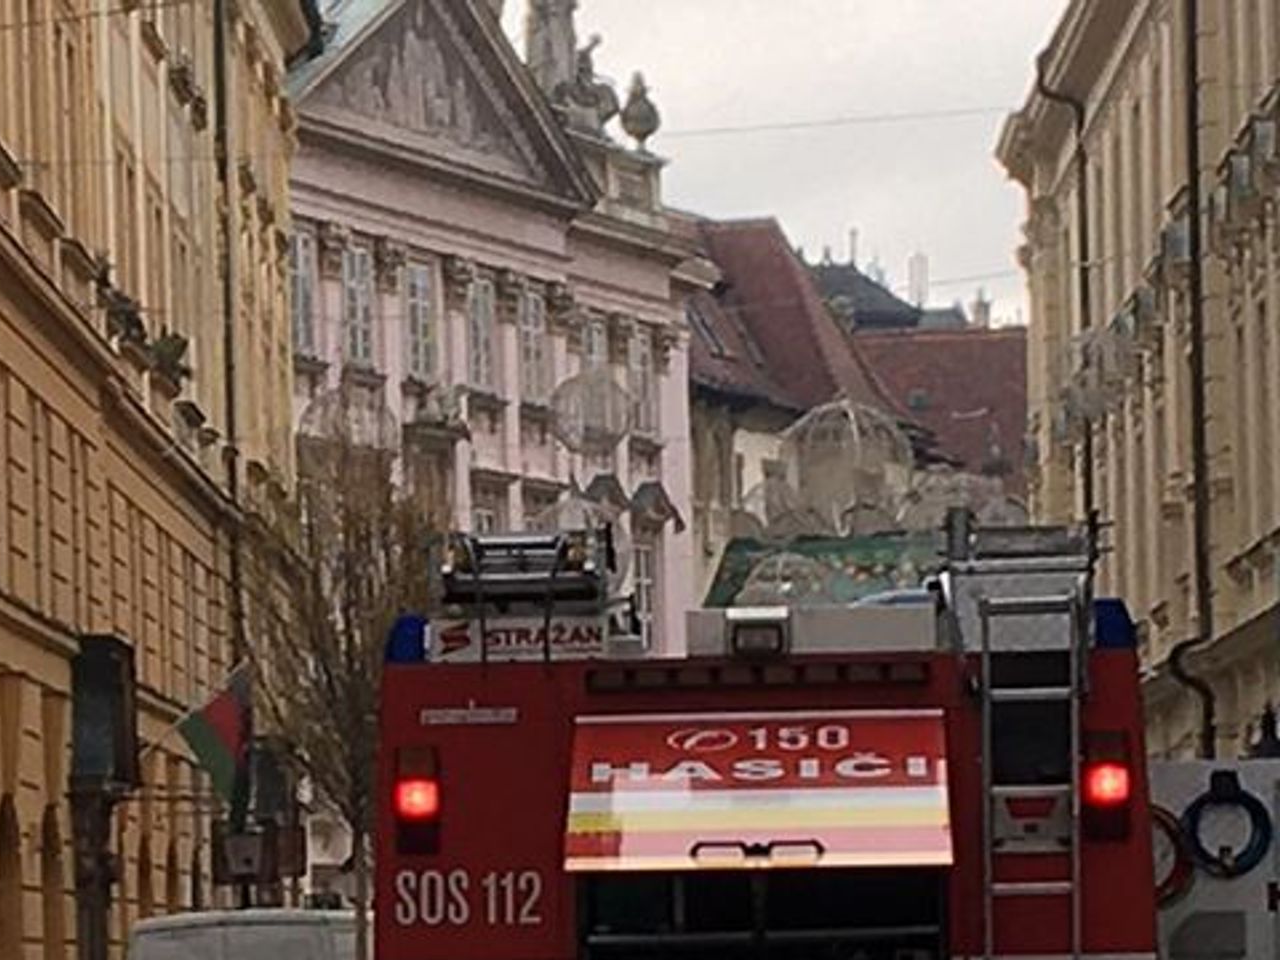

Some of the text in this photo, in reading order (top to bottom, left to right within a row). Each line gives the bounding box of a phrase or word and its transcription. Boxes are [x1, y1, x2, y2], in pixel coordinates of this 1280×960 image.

[748, 725, 850, 750] 150
[590, 751, 928, 782] HASIČI
[395, 869, 542, 925] SOS 112
